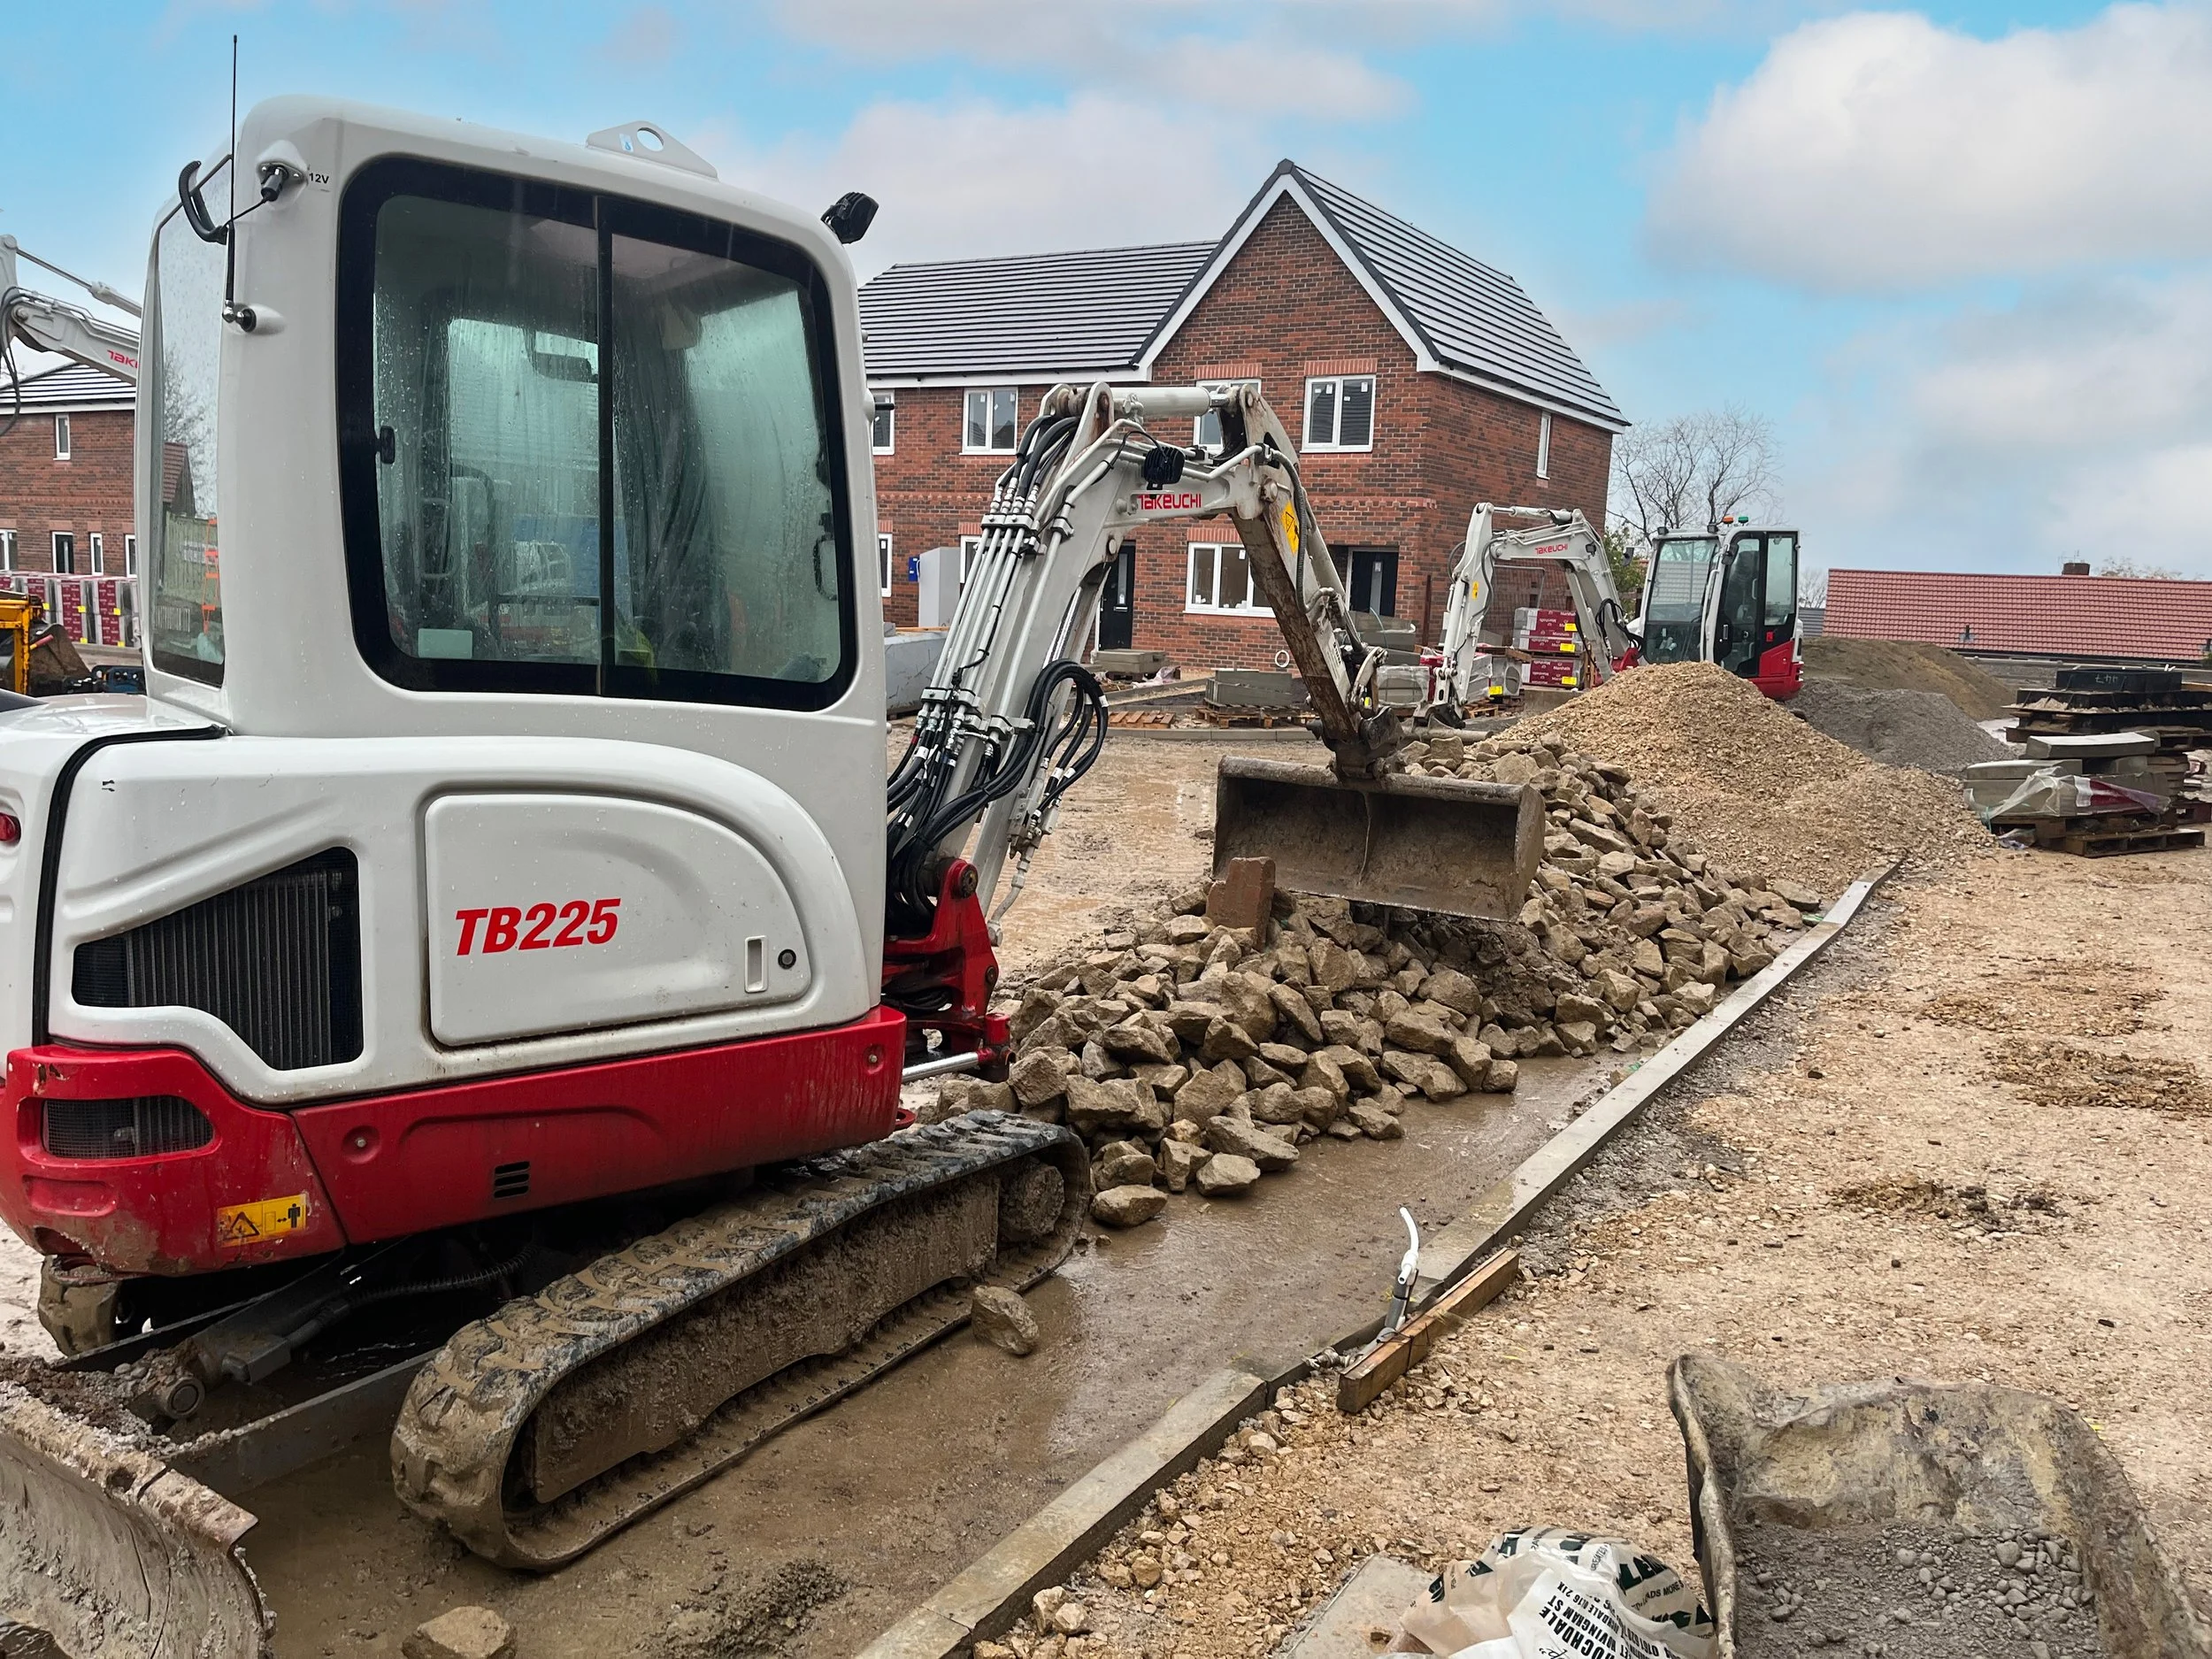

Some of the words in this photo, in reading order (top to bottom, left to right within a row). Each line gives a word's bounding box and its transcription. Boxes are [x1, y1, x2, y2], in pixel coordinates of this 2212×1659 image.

[309, 173, 329, 184] 12V
[107, 349, 139, 368] TAK
[455, 898, 621, 956] TB225
[1548, 1595, 1564, 1612] ST
